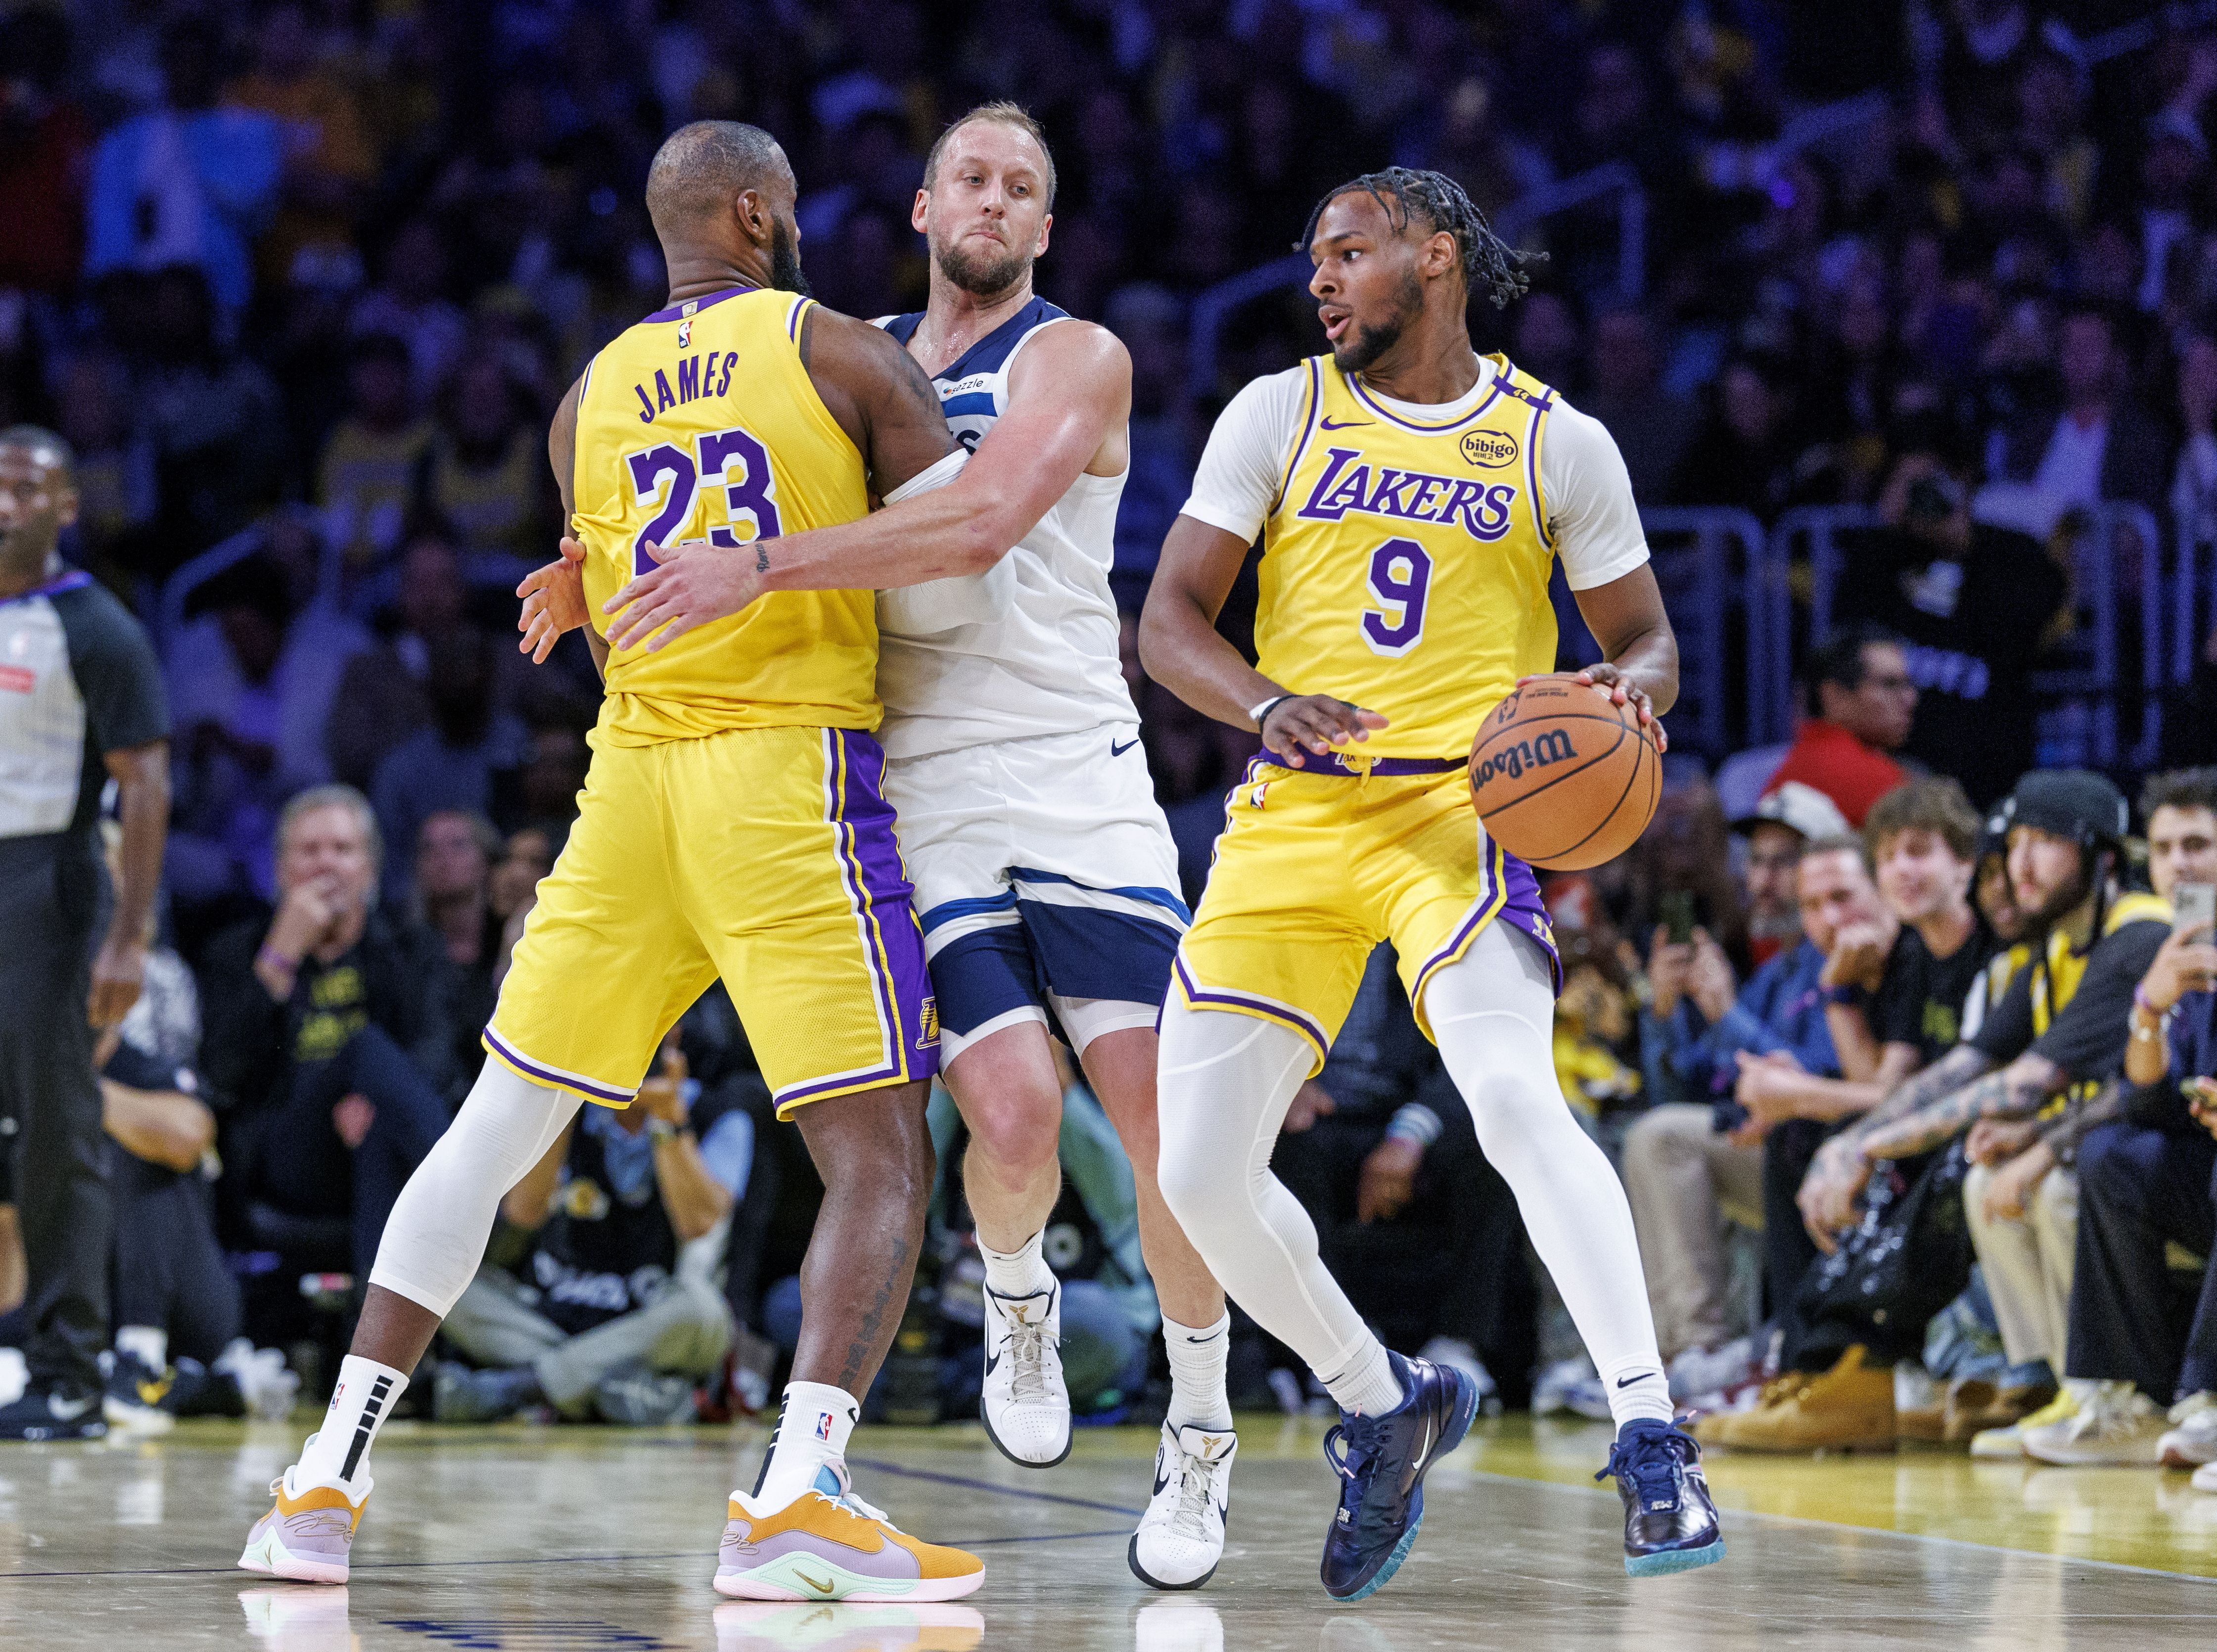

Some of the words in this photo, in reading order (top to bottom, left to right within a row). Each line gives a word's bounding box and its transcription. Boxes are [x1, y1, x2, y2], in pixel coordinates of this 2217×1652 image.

[635, 352, 738, 423] JAMES
[951, 378, 983, 394] sezzle
[1513, 389, 1529, 400] 44
[1466, 438, 1514, 458] bibigo
[625, 427, 784, 581] 23
[1295, 447, 1519, 543] LAKERS
[1359, 536, 1434, 658] 9
[1471, 729, 1578, 793] Wilson
